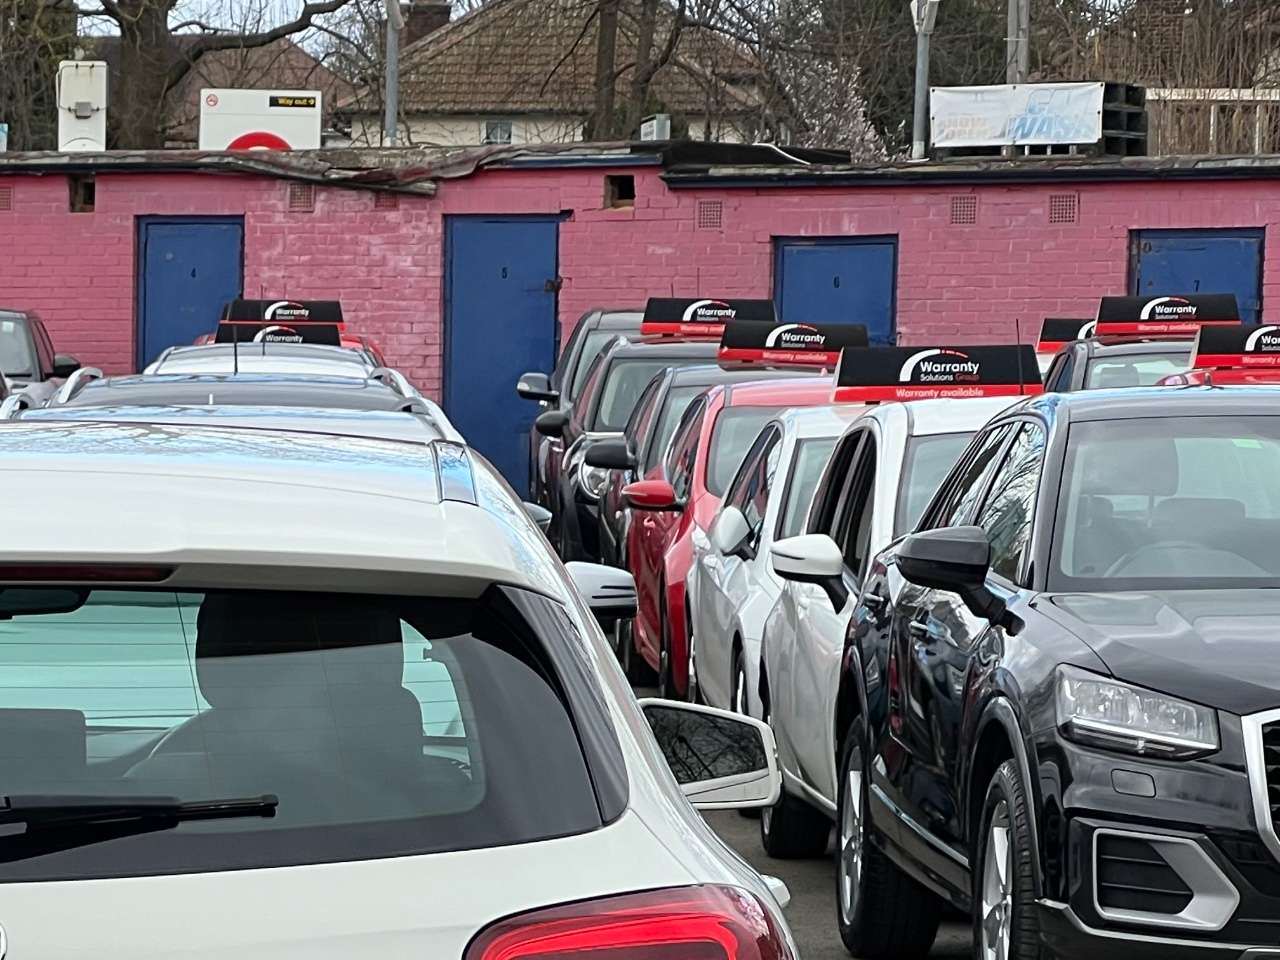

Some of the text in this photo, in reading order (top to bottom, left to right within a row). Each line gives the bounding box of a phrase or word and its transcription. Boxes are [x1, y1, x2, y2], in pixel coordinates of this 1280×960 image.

[275, 308, 310, 317] Warranty
[696, 307, 737, 318] Warranty
[1155, 305, 1197, 315] Warranty
[265, 334, 304, 343] Warranty
[781, 332, 825, 344] Warranty
[920, 361, 980, 374] Warranty
[920, 373, 953, 382] Solutions
[896, 387, 984, 398] Warranty available
